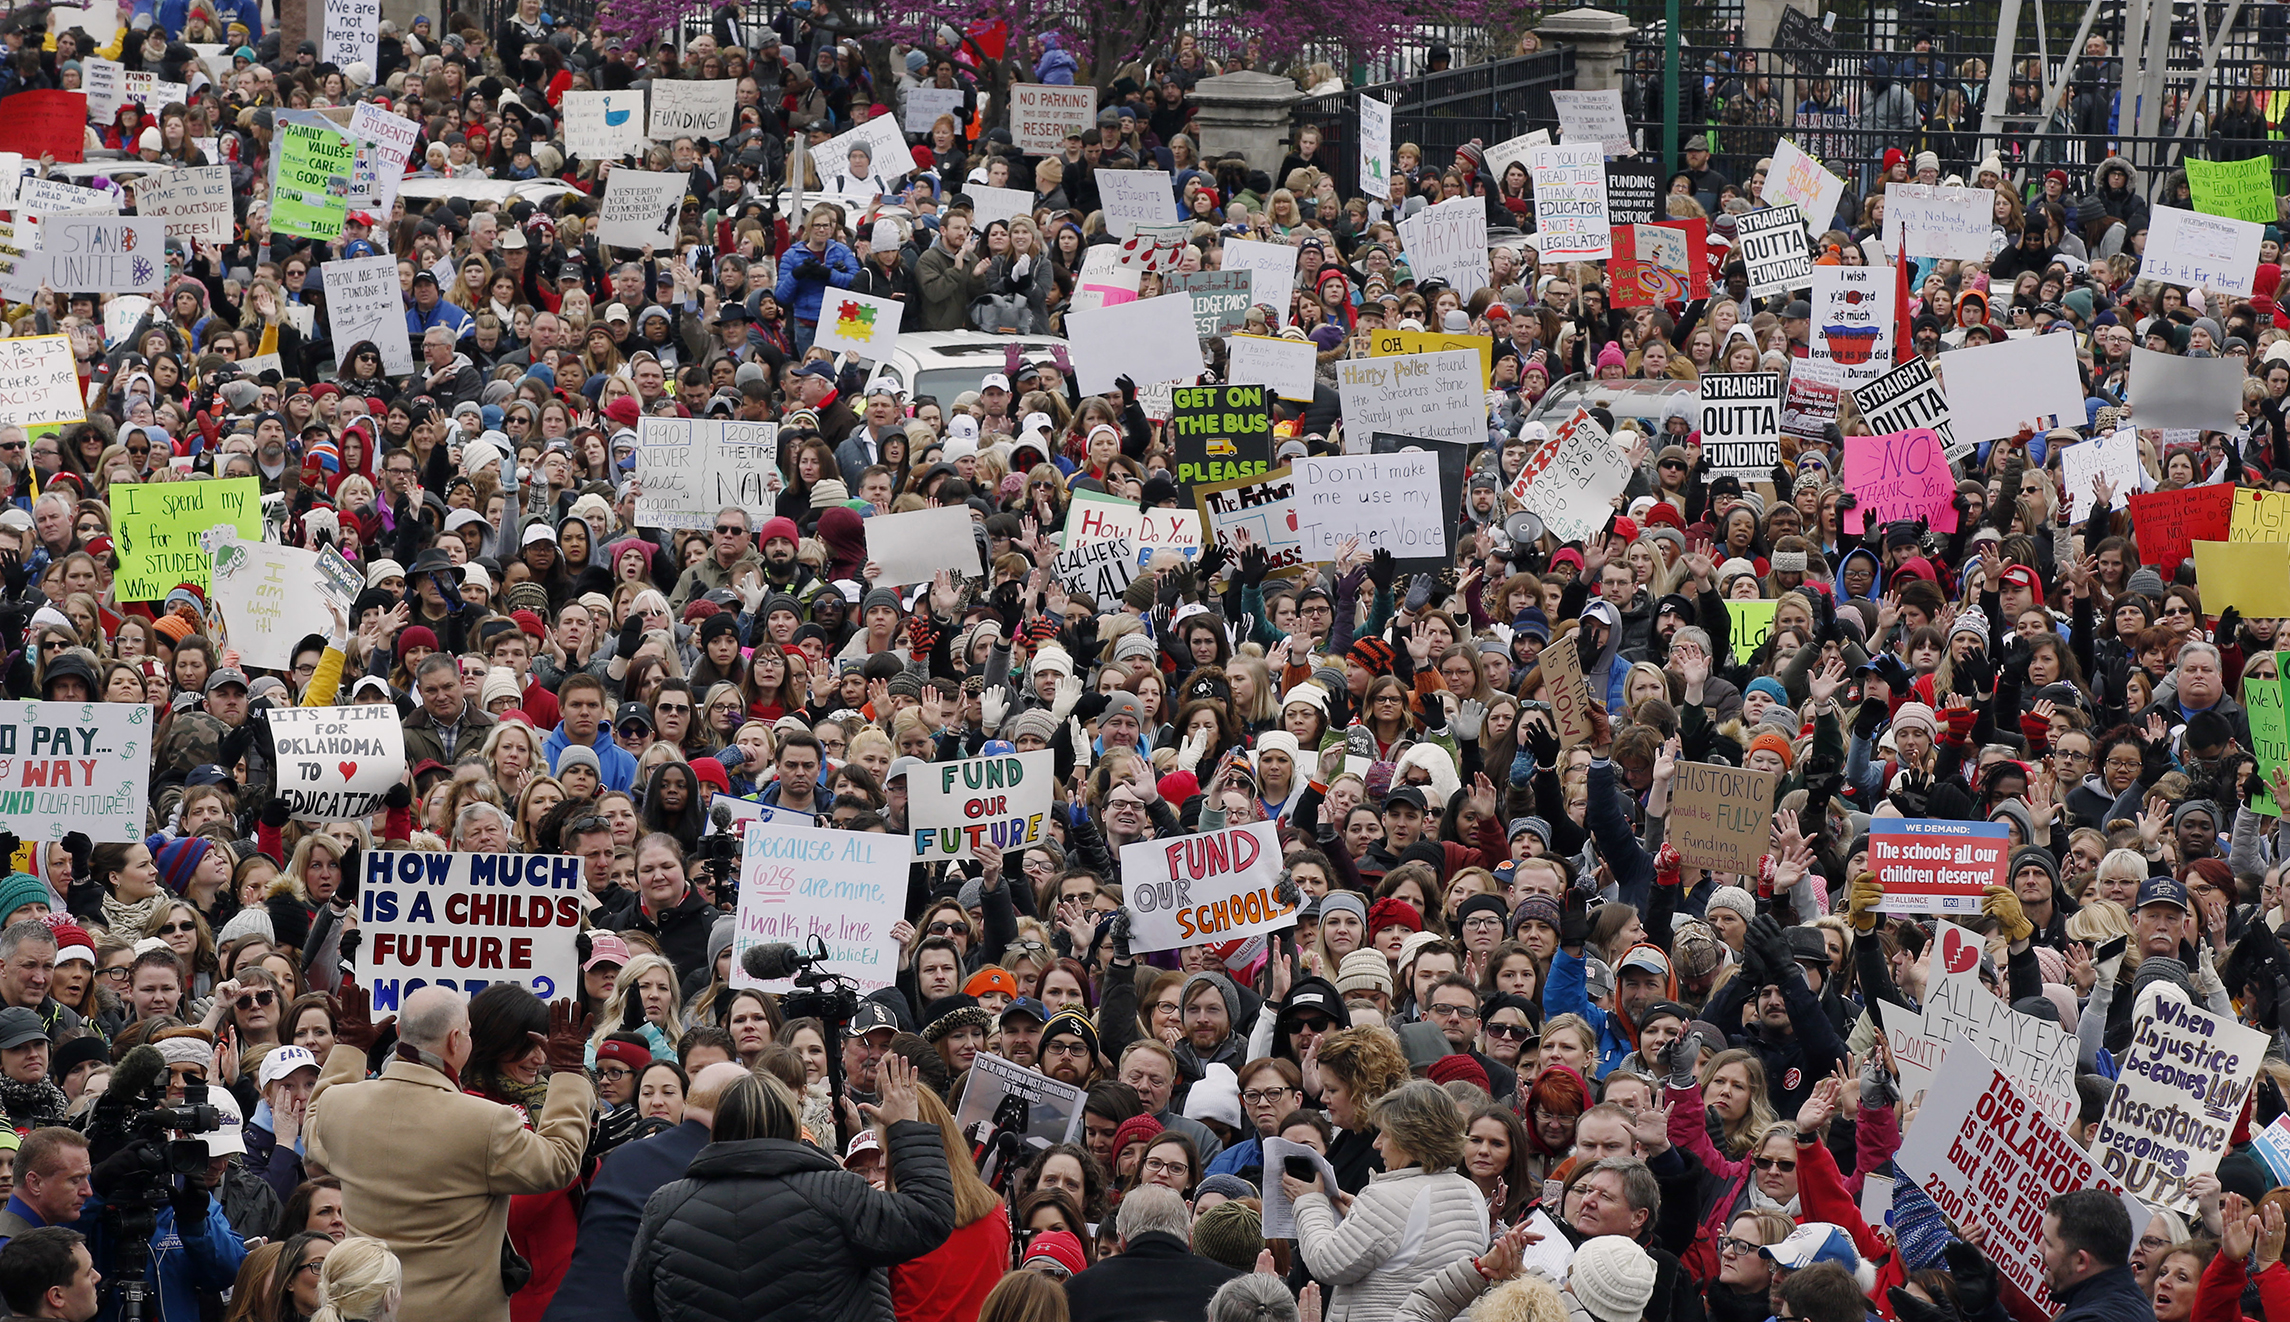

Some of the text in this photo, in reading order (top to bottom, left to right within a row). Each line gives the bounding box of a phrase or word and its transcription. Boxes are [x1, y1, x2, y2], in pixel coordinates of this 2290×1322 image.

[355, 4, 375, 14] are
[340, 16, 361, 28] not
[327, 26, 375, 43] here to
[339, 43, 360, 55] say
[126, 73, 151, 82] FUND
[126, 83, 151, 91] KIDS
[1020, 93, 1088, 108] NO PARKING
[287, 125, 323, 140] FAMILY
[362, 117, 415, 145] STUDENTS
[309, 158, 334, 172] CARE
[1536, 152, 1602, 166] IF YOU CAN
[134, 168, 223, 195] NOW IS THE
[1540, 171, 1566, 182] READ
[1609, 175, 1655, 188] FUNDING
[36, 191, 87, 204] AHEAD AND
[56, 183, 98, 197] COULD GO
[142, 186, 197, 206] TIME TO
[276, 187, 302, 201] FUND
[613, 187, 663, 196] YESTERDAY
[634, 195, 657, 203] SAID
[1117, 192, 1161, 202] STUDENTS
[1539, 188, 1598, 200] THANK AN
[26, 199, 48, 210] FULLY
[175, 202, 228, 215] OUTSIDE
[607, 202, 662, 213] TOMORROW
[1110, 204, 1163, 220] DESERVE
[1540, 202, 1602, 216] EDUCATOR
[605, 212, 641, 222] SO JUST
[1424, 207, 1480, 224] Before you
[1738, 206, 1798, 232] STRAIGHT
[1548, 220, 1586, 231] NOT A
[63, 226, 138, 252] STAND
[1541, 234, 1609, 250] LEGISLATOR!
[1744, 230, 1805, 261] OUTTA
[1453, 254, 1481, 268] should
[326, 267, 394, 286] SHOW ME THE
[1749, 257, 1810, 286] FUNDING
[1846, 271, 1866, 281] wish
[2147, 260, 2244, 289] I do it them!
[1834, 311, 1870, 321] as much
[1382, 338, 1403, 352] OH
[1436, 355, 1467, 372] found
[1875, 350, 1888, 359] did
[50, 372, 73, 383] ARE
[1848, 368, 1879, 378] Durant!
[1435, 377, 1468, 392] Stone
[1702, 376, 1776, 397] STRAIGHT
[1856, 360, 1928, 411] STRAIGHT
[1173, 387, 1261, 408] GET ON
[28, 410, 85, 421] MY MIND
[1397, 403, 1440, 422] you can
[1703, 406, 1776, 436] OUTTA
[1175, 413, 1268, 435] THE BUS
[1307, 460, 1426, 484] Don't make
[126, 486, 244, 520] I spend my
[1313, 490, 1430, 508] me use my
[149, 524, 171, 548] for
[1392, 517, 1443, 545] Voice
[2167, 527, 2188, 540] NOW
[256, 584, 283, 599] am
[272, 706, 389, 722] IT'S TIME
[315, 723, 348, 734] FOR
[278, 738, 384, 756] OKLAHOMA
[21, 759, 97, 788] WAY
[298, 761, 322, 780] TO
[942, 758, 1023, 794] FUND
[1676, 764, 1764, 802] HISTORIC
[39, 793, 69, 814] OUR
[964, 795, 1007, 819] OUR
[1673, 804, 1762, 834] would be FULLY
[916, 812, 1042, 855] FUTURE
[1906, 824, 1969, 834] WE DEMAND:
[748, 828, 834, 862] Because
[1877, 842, 1998, 863] The schools all our
[1165, 829, 1260, 882] FUND
[367, 852, 578, 890] HOW MUCH
[753, 864, 796, 888] 628
[1880, 866, 1994, 886] children deserve!
[1134, 878, 1193, 913] OUR
[363, 891, 580, 927] IS A CHILD'S
[1176, 885, 1294, 940] SCHOOLS
[373, 934, 533, 969] FUTURE
[2155, 995, 2215, 1037] When
[280, 1048, 312, 1061] EAST
[995, 1064, 1041, 1089] YOU COULD JUST
[1002, 1082, 1022, 1097] TO THE
[1989, 1069, 2092, 1180] The future
[2108, 1083, 2225, 1154] Resistance
[1961, 1111, 2019, 1183] is in my
[2100, 1122, 2189, 1176] becomes
[1948, 1135, 2009, 1209] but the
[1924, 1173, 1963, 1219] 2300
[1963, 1185, 2029, 1255] is found
